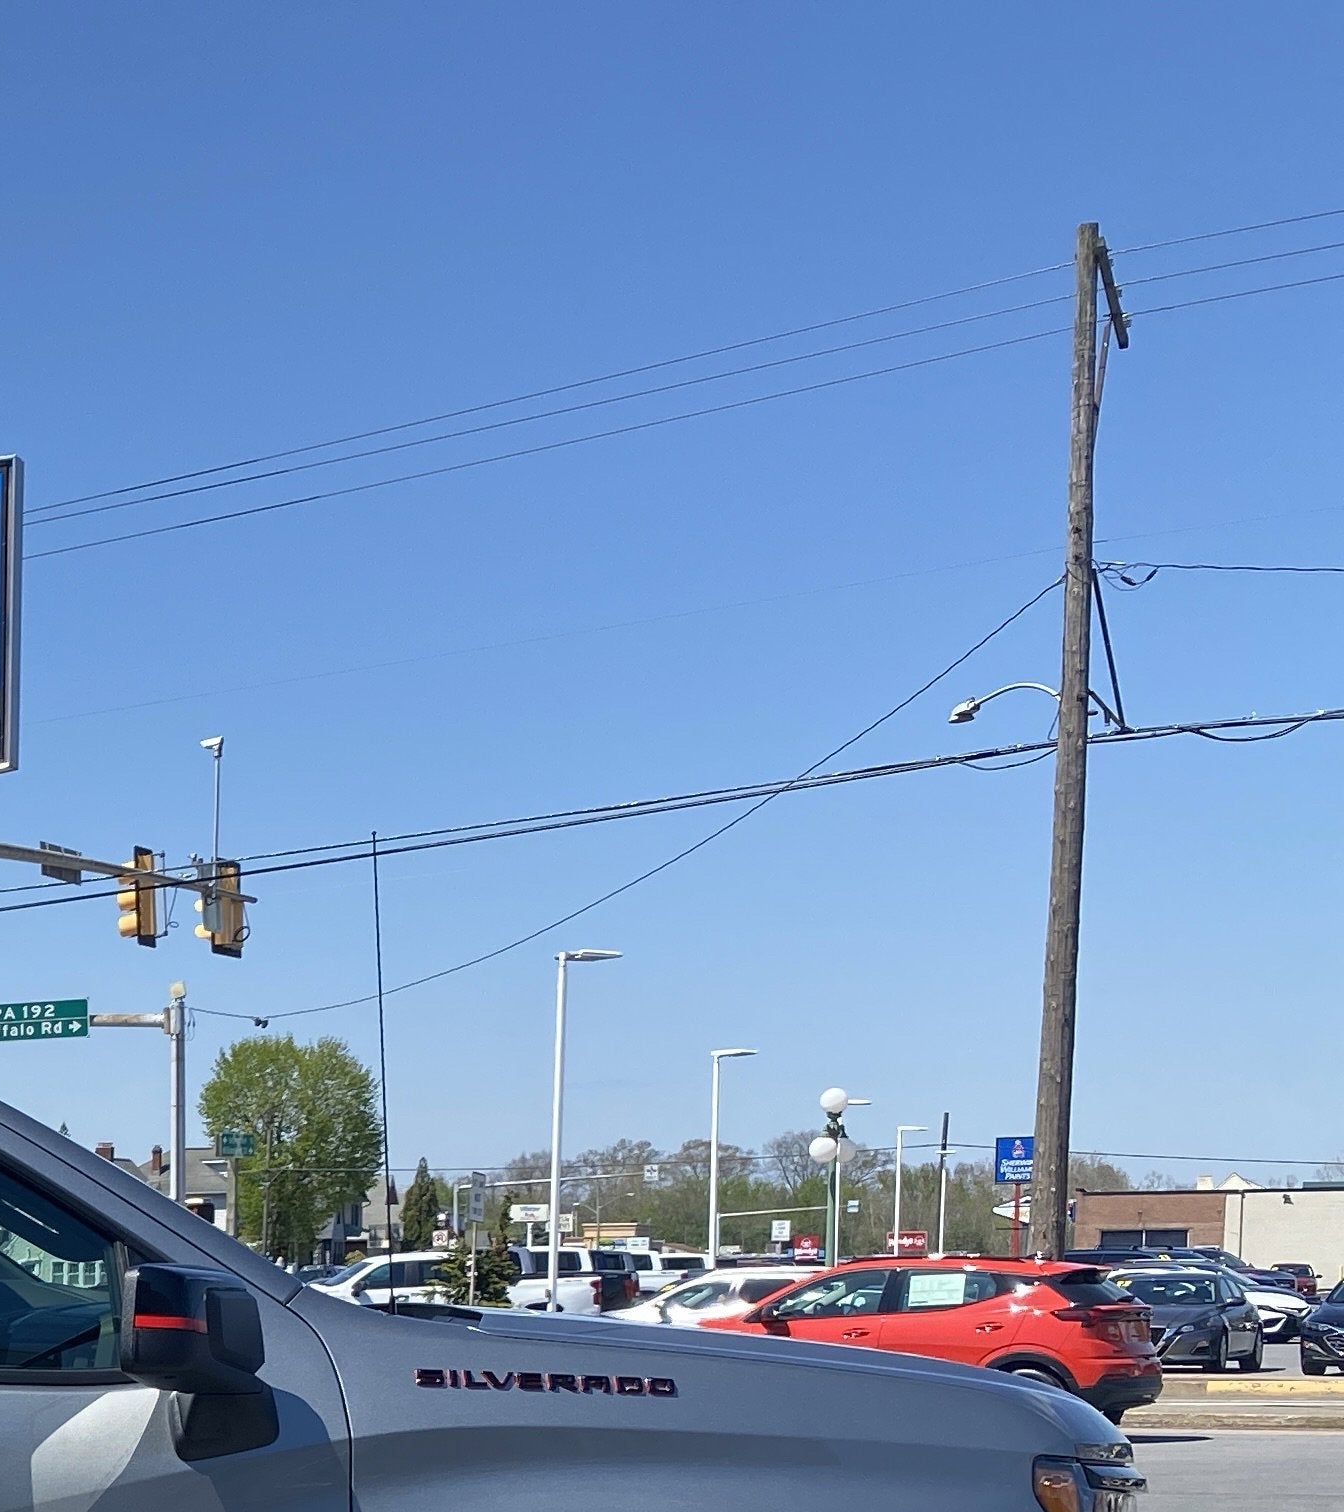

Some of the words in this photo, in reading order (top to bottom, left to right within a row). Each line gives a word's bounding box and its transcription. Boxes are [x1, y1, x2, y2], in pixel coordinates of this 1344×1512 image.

[22, 1004, 55, 1019] 192
[41, 1020, 63, 1035] Rd
[413, 1369, 678, 1397] SILVERADO
